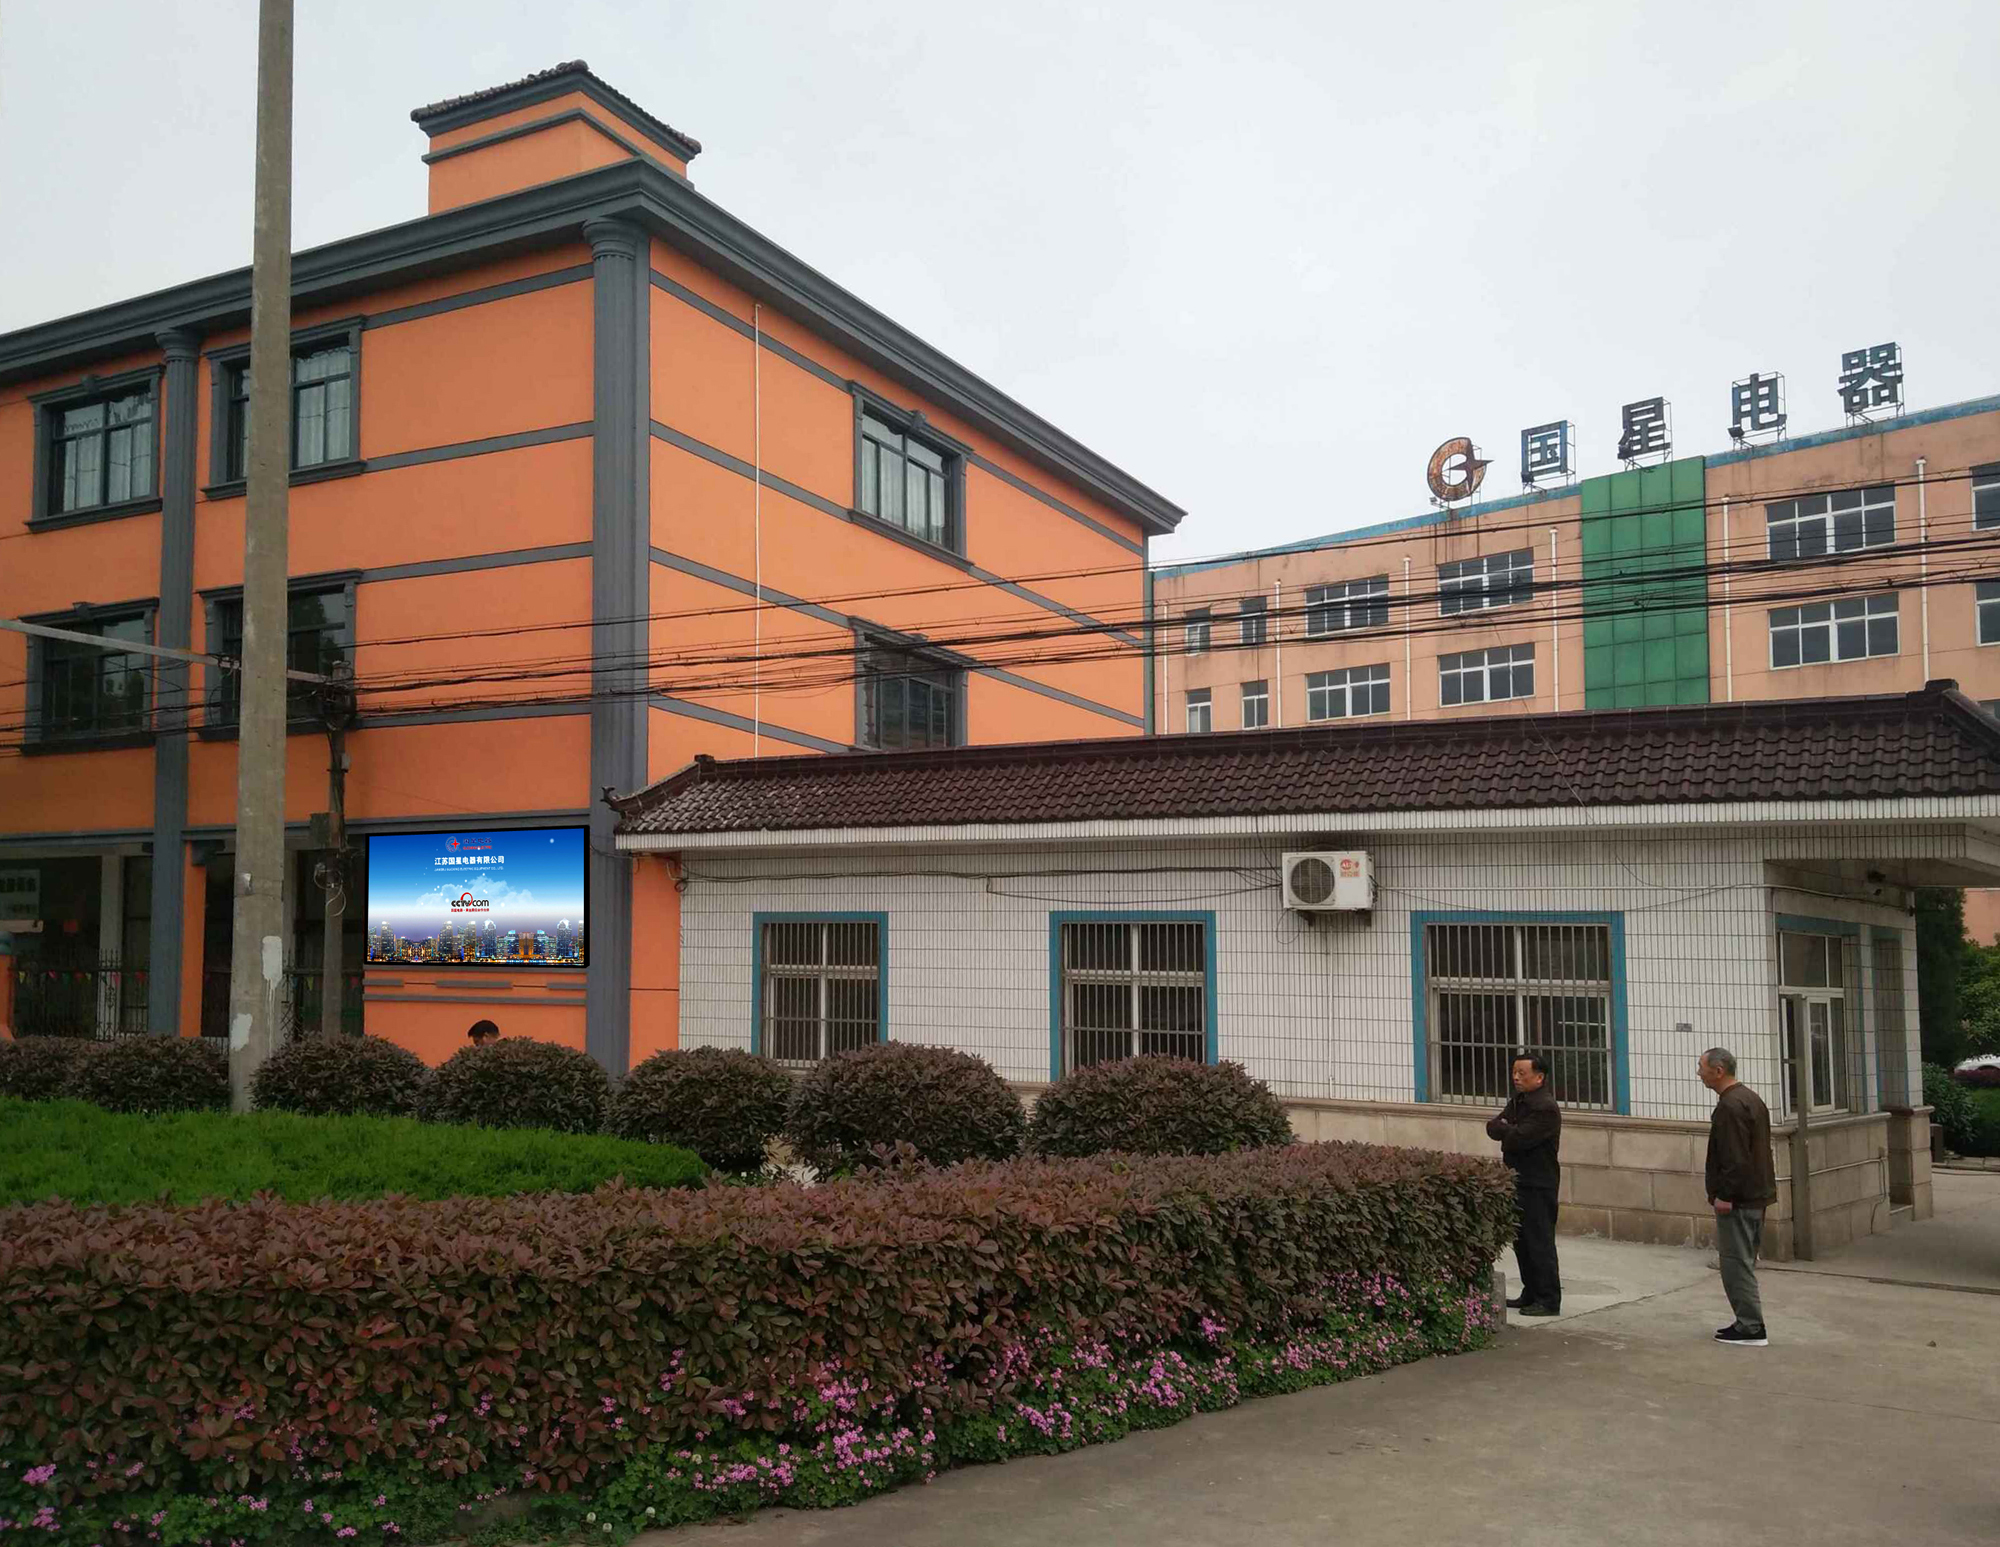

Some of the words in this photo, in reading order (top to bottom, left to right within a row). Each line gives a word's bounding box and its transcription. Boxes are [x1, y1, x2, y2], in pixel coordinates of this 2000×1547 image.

[1521, 342, 1903, 479] 国星电器
[434, 855, 505, 866] 江苏国星电器有限公司
